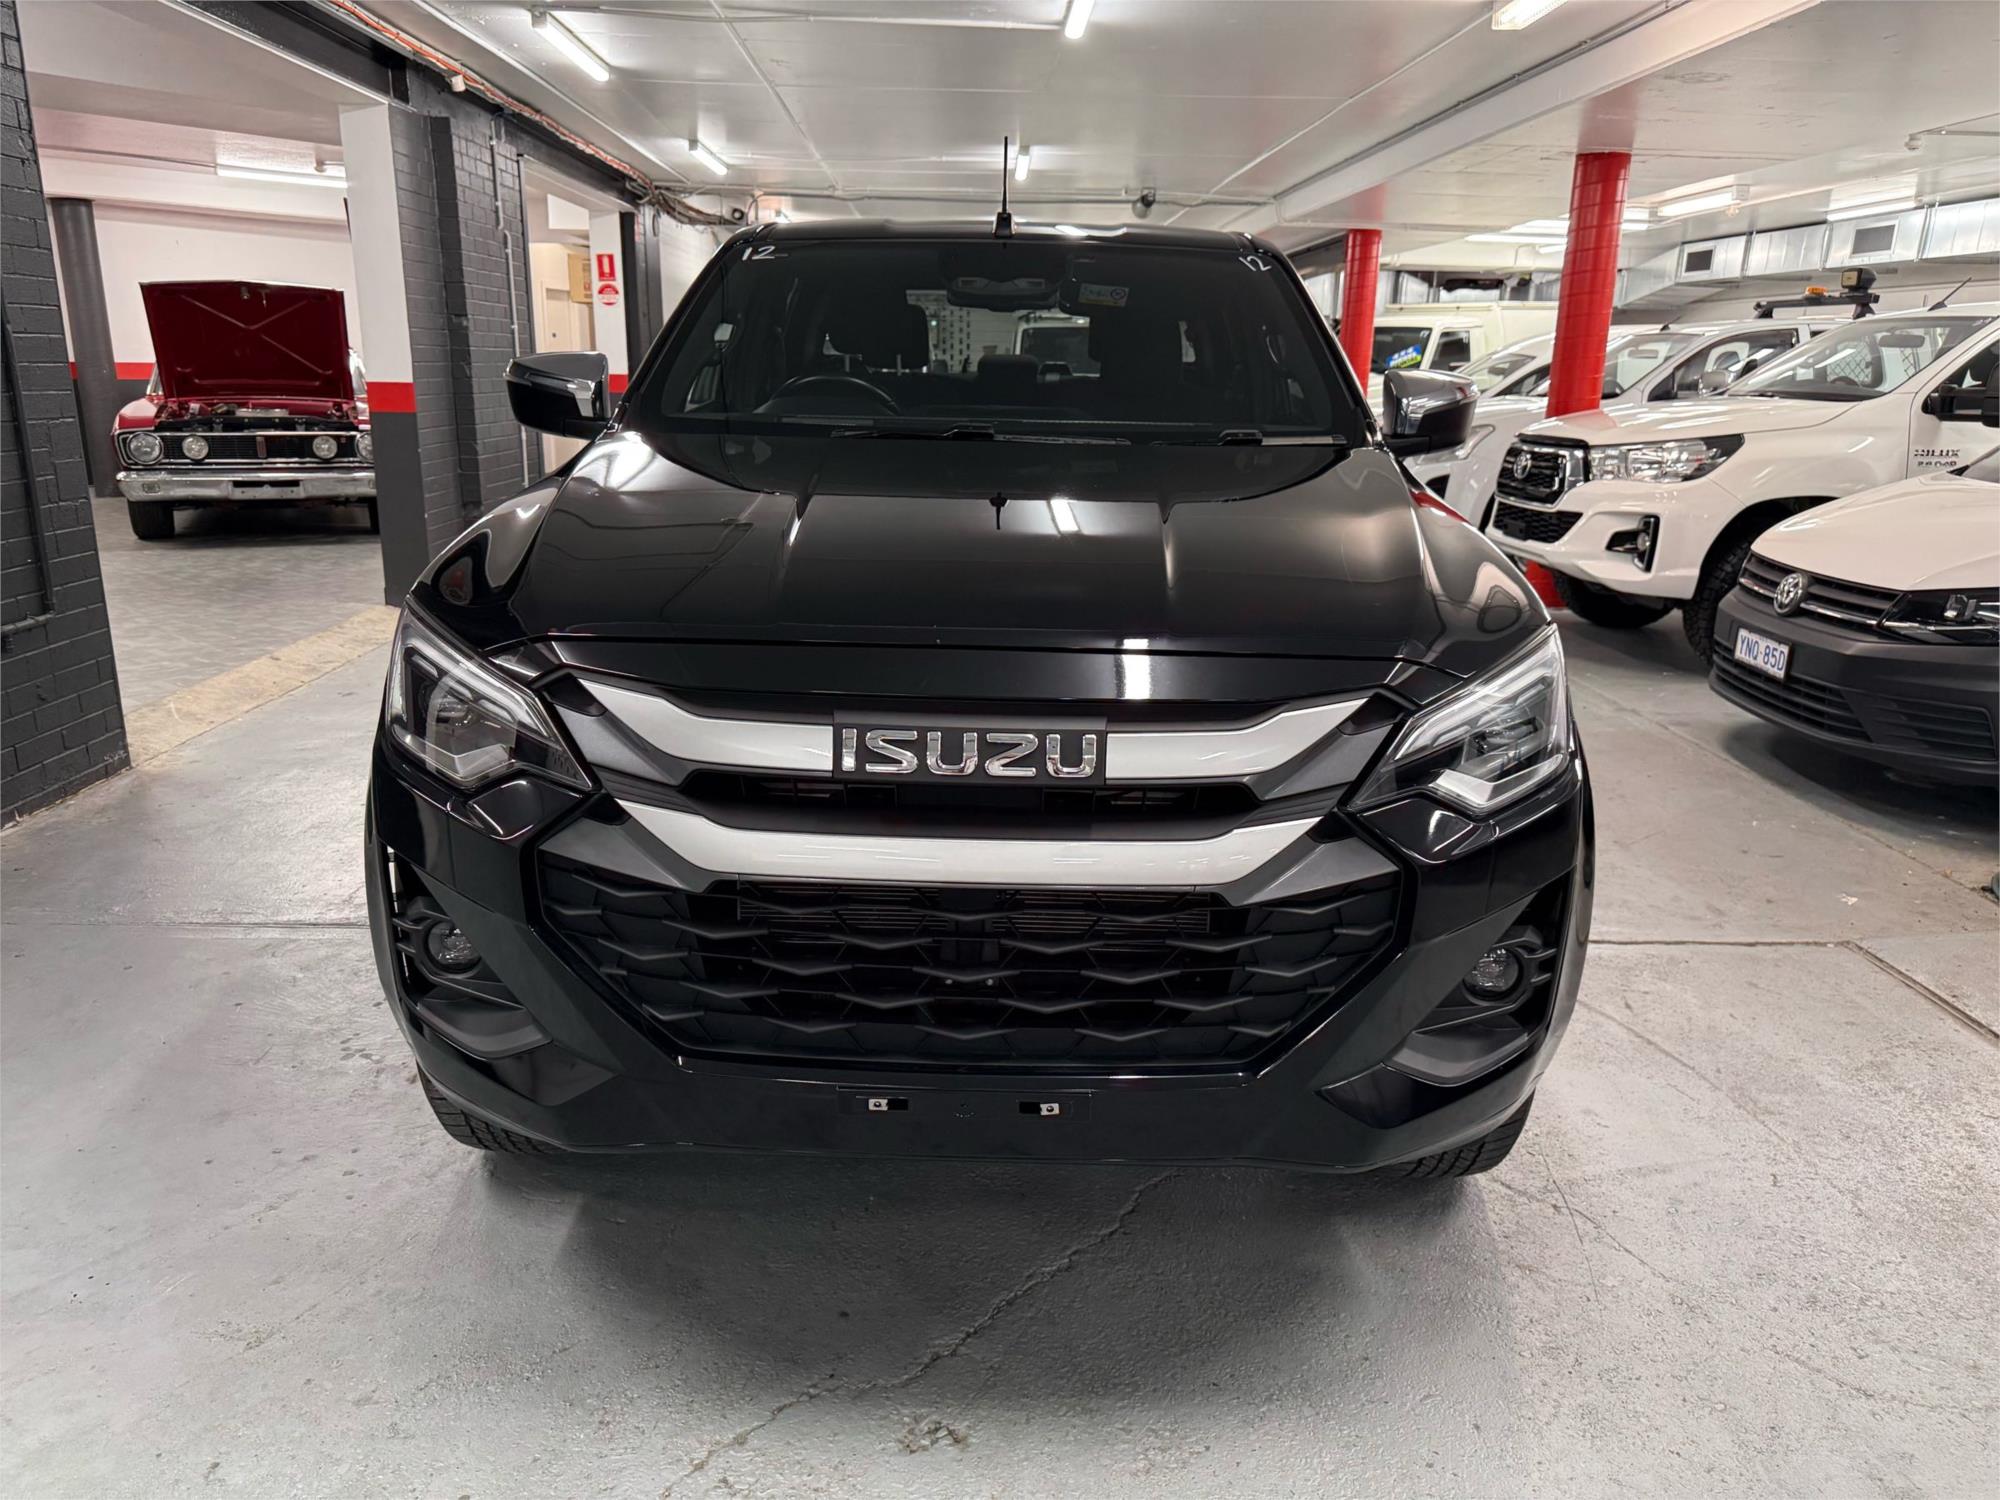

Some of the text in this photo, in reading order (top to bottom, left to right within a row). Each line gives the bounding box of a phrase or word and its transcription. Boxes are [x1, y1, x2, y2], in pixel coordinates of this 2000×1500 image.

[742, 245, 776, 261] 12
[1238, 255, 1272, 272] 12
[841, 727, 1097, 778] ISUZU
